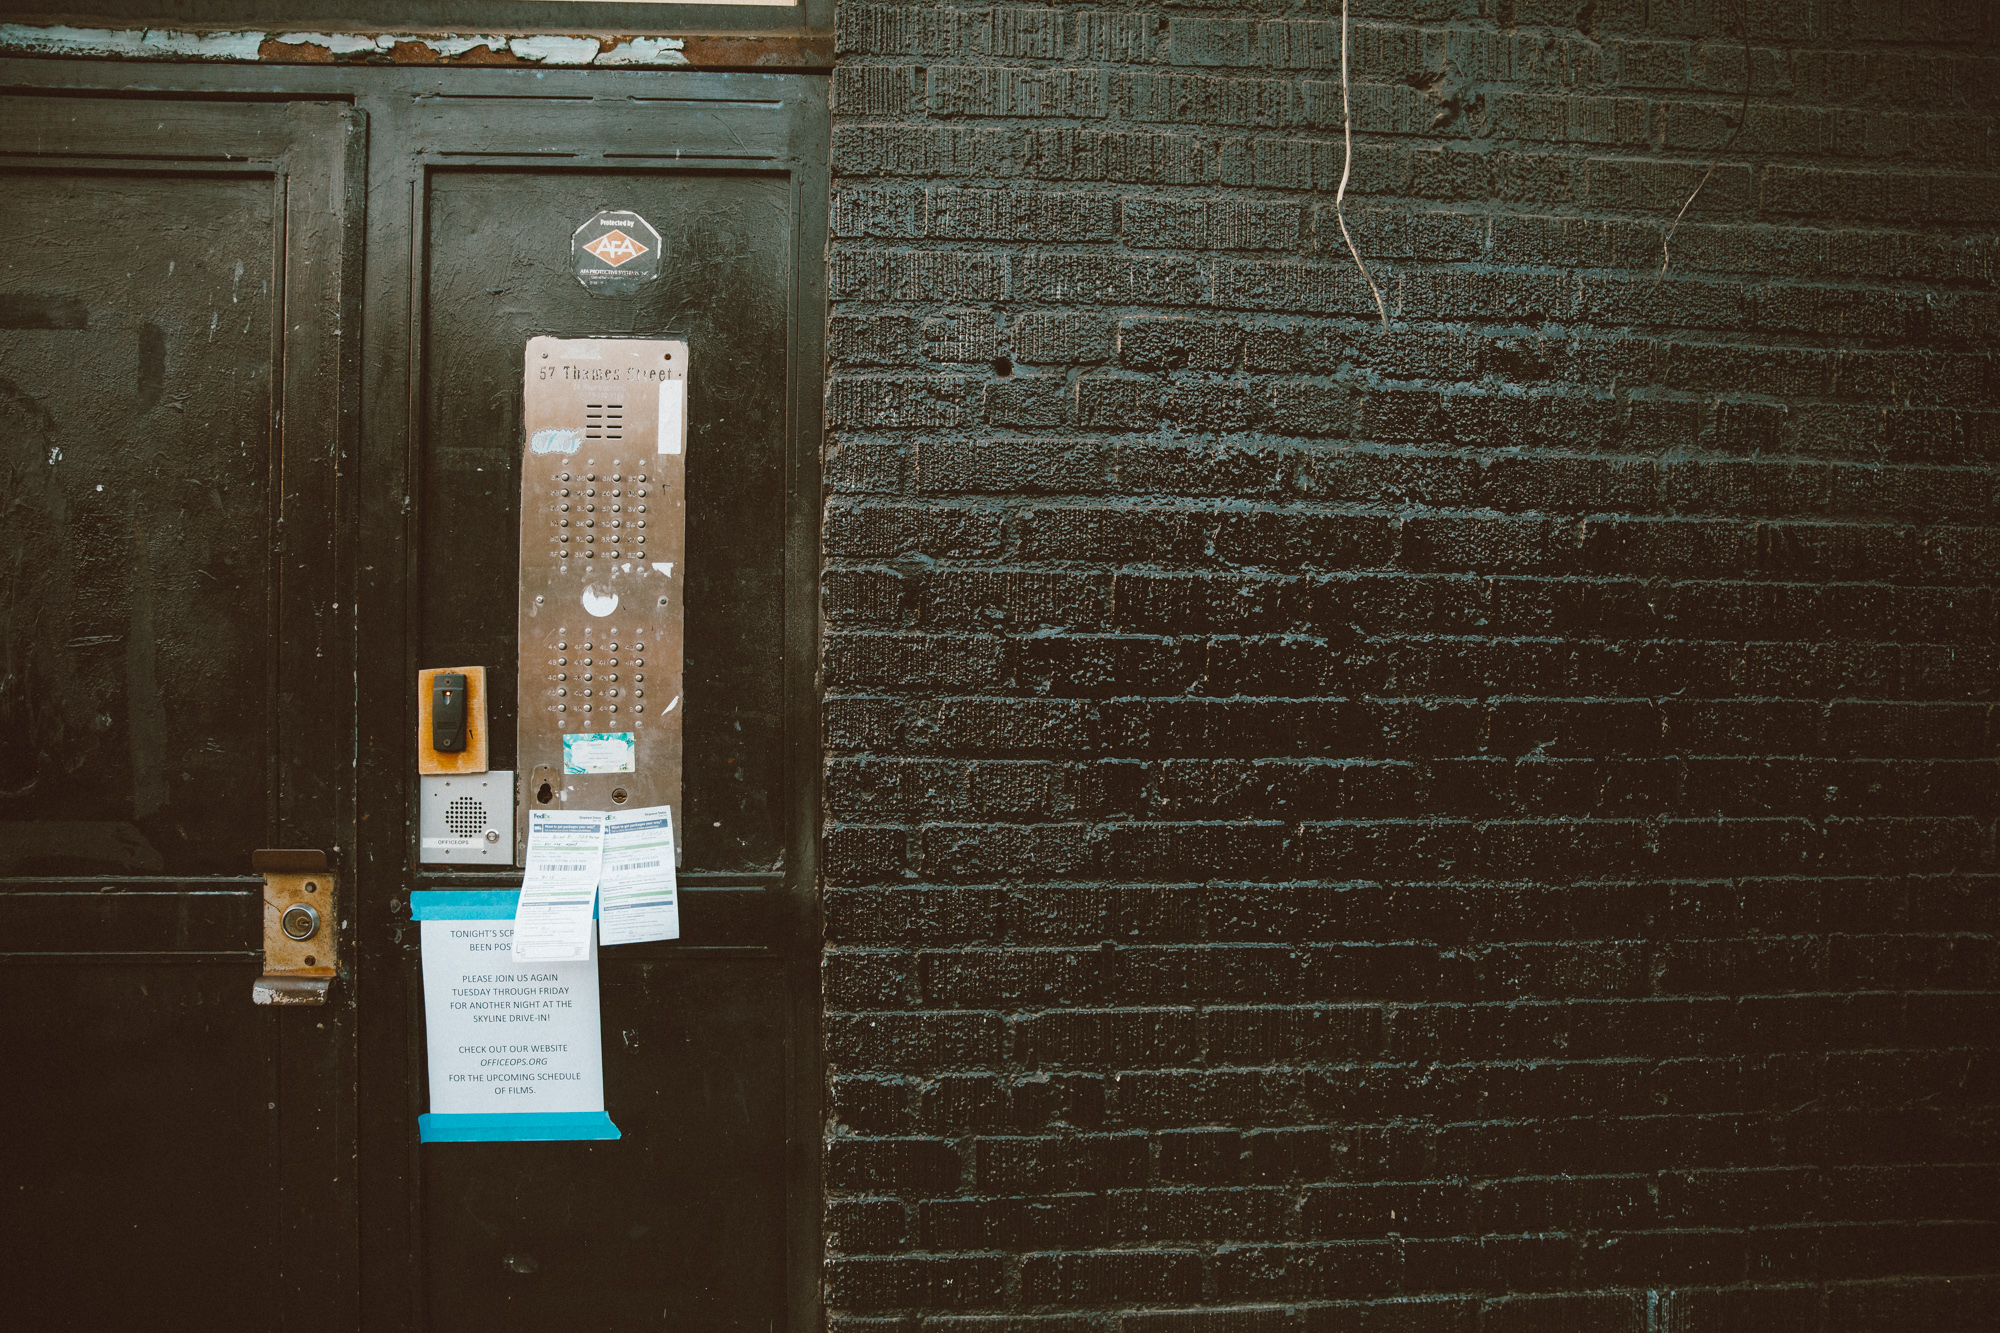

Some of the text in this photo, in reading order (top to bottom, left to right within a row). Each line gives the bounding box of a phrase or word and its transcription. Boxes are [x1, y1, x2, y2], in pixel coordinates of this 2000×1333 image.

[627, 220, 634, 228] by
[595, 236, 637, 258] AFA
[540, 365, 672, 382] 57 Thames Street
[450, 930, 497, 938] TONIGHT'S
[470, 943, 492, 951] BEEN
[494, 943, 513, 951] POS
[462, 975, 492, 983] PLEASE
[469, 1001, 511, 1009] ANOTHER
[509, 1014, 550, 1022] DRIVE-IN!
[480, 1058, 548, 1066] OFFICEOPS.ORG
[486, 1073, 535, 1082] UPCOMING
[537, 1072, 581, 1080] SCHEDULE
